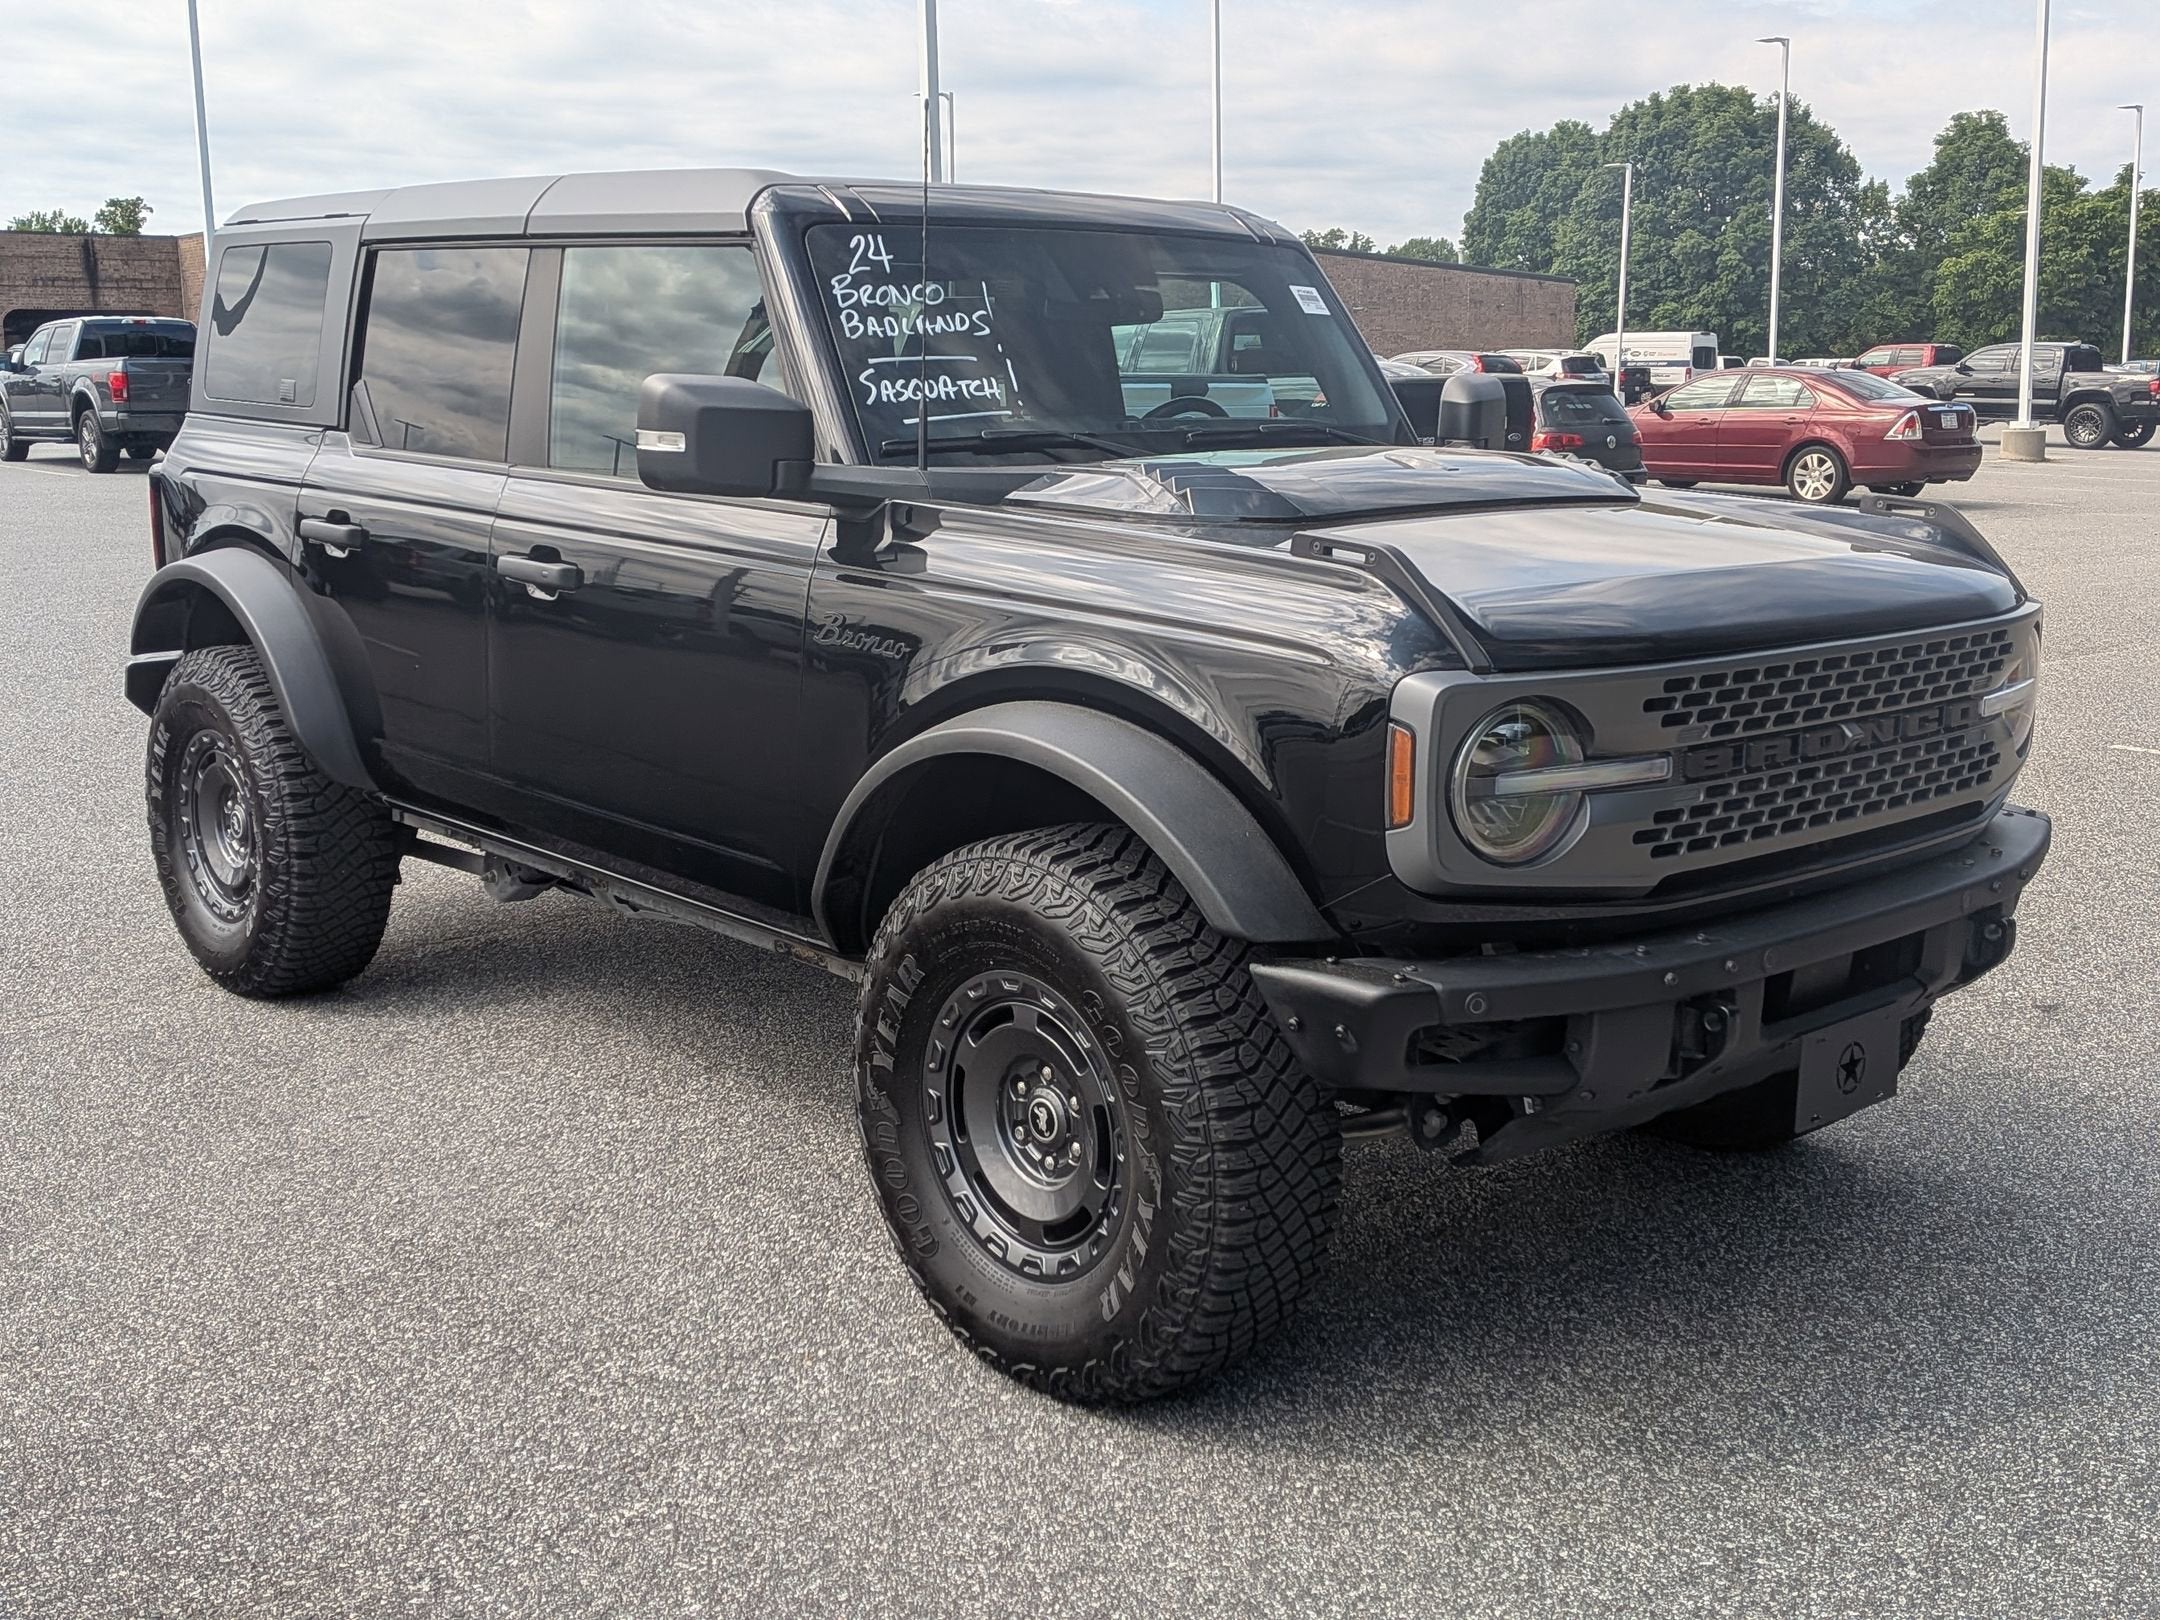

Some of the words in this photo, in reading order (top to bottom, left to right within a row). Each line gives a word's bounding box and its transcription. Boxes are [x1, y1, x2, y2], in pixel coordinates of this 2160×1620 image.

[848, 234, 894, 274] 24
[831, 274, 944, 308] BRONCO
[813, 611, 912, 660] Bronco
[1684, 701, 1982, 779] BRONCO
